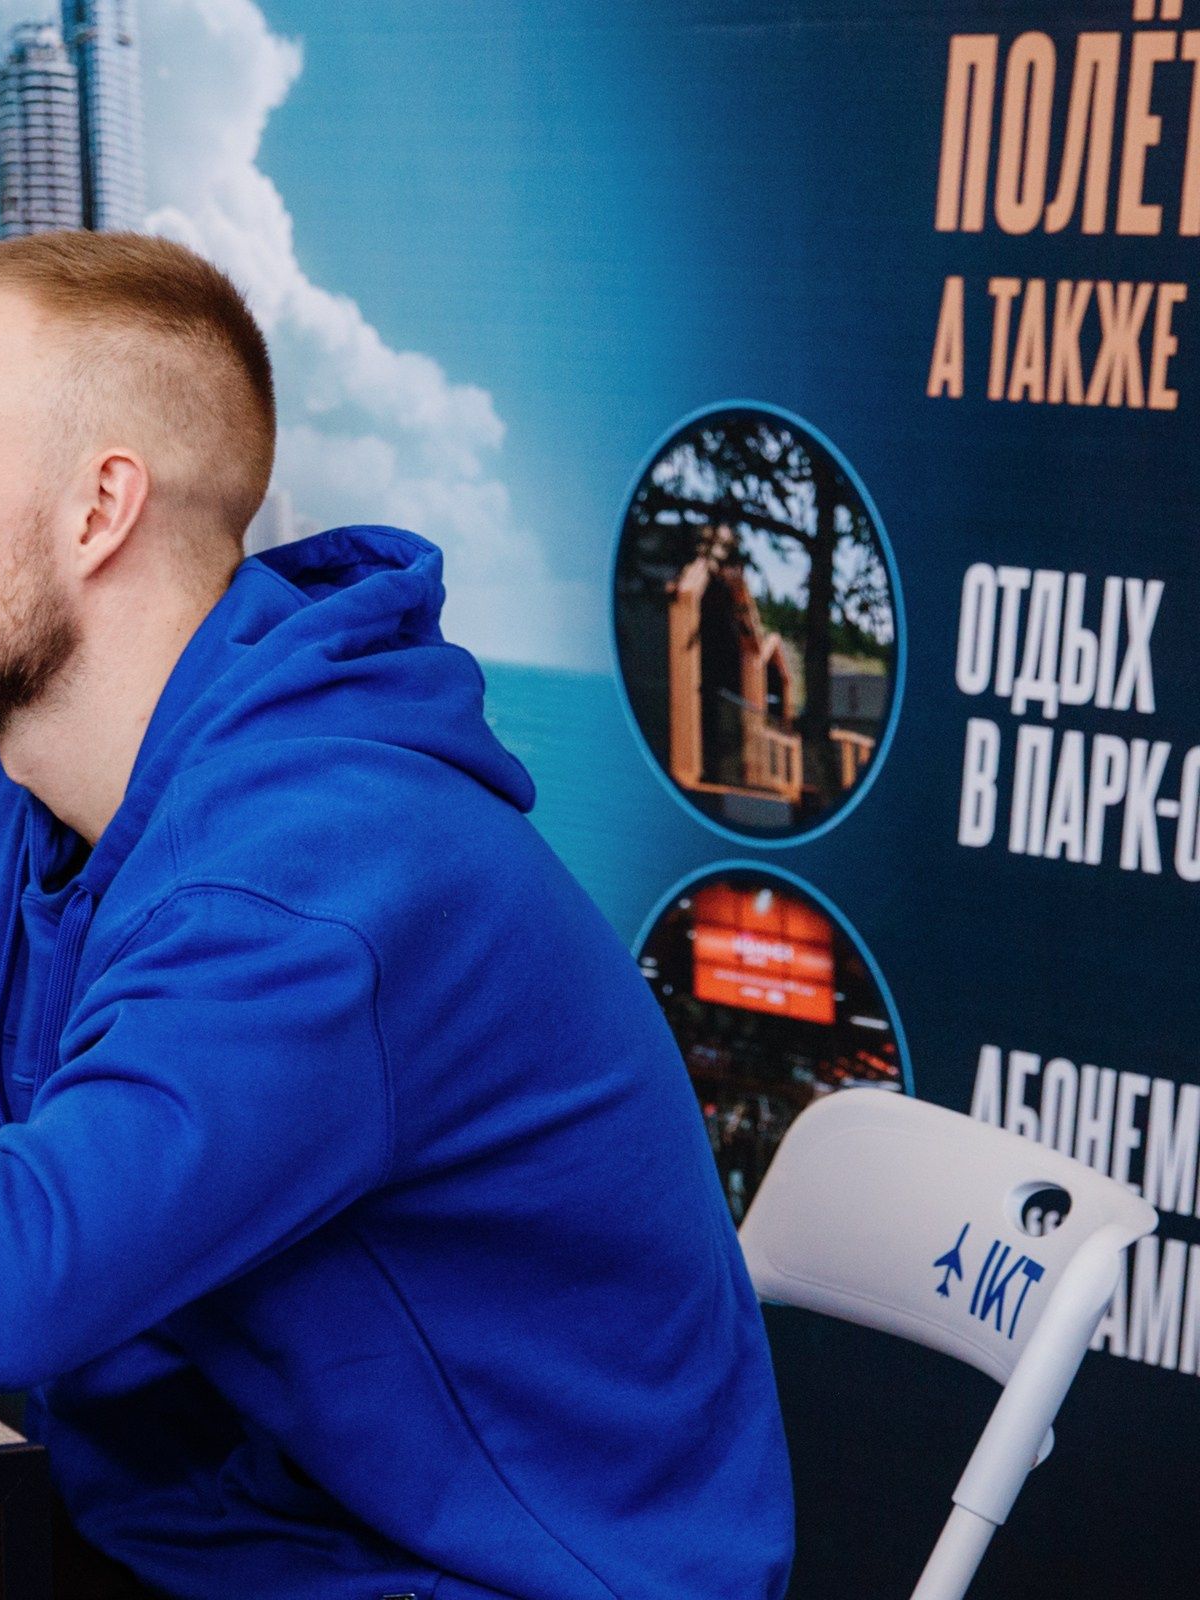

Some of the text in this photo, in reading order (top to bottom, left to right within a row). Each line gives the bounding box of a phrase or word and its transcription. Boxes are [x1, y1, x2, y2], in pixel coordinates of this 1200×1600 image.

[926, 275, 1189, 411] А ТАКЖЕ
[955, 562, 1166, 720] ОТДЫХ
[957, 717, 1002, 848] В
[969, 1043, 1200, 1219] АБОНЕМ
